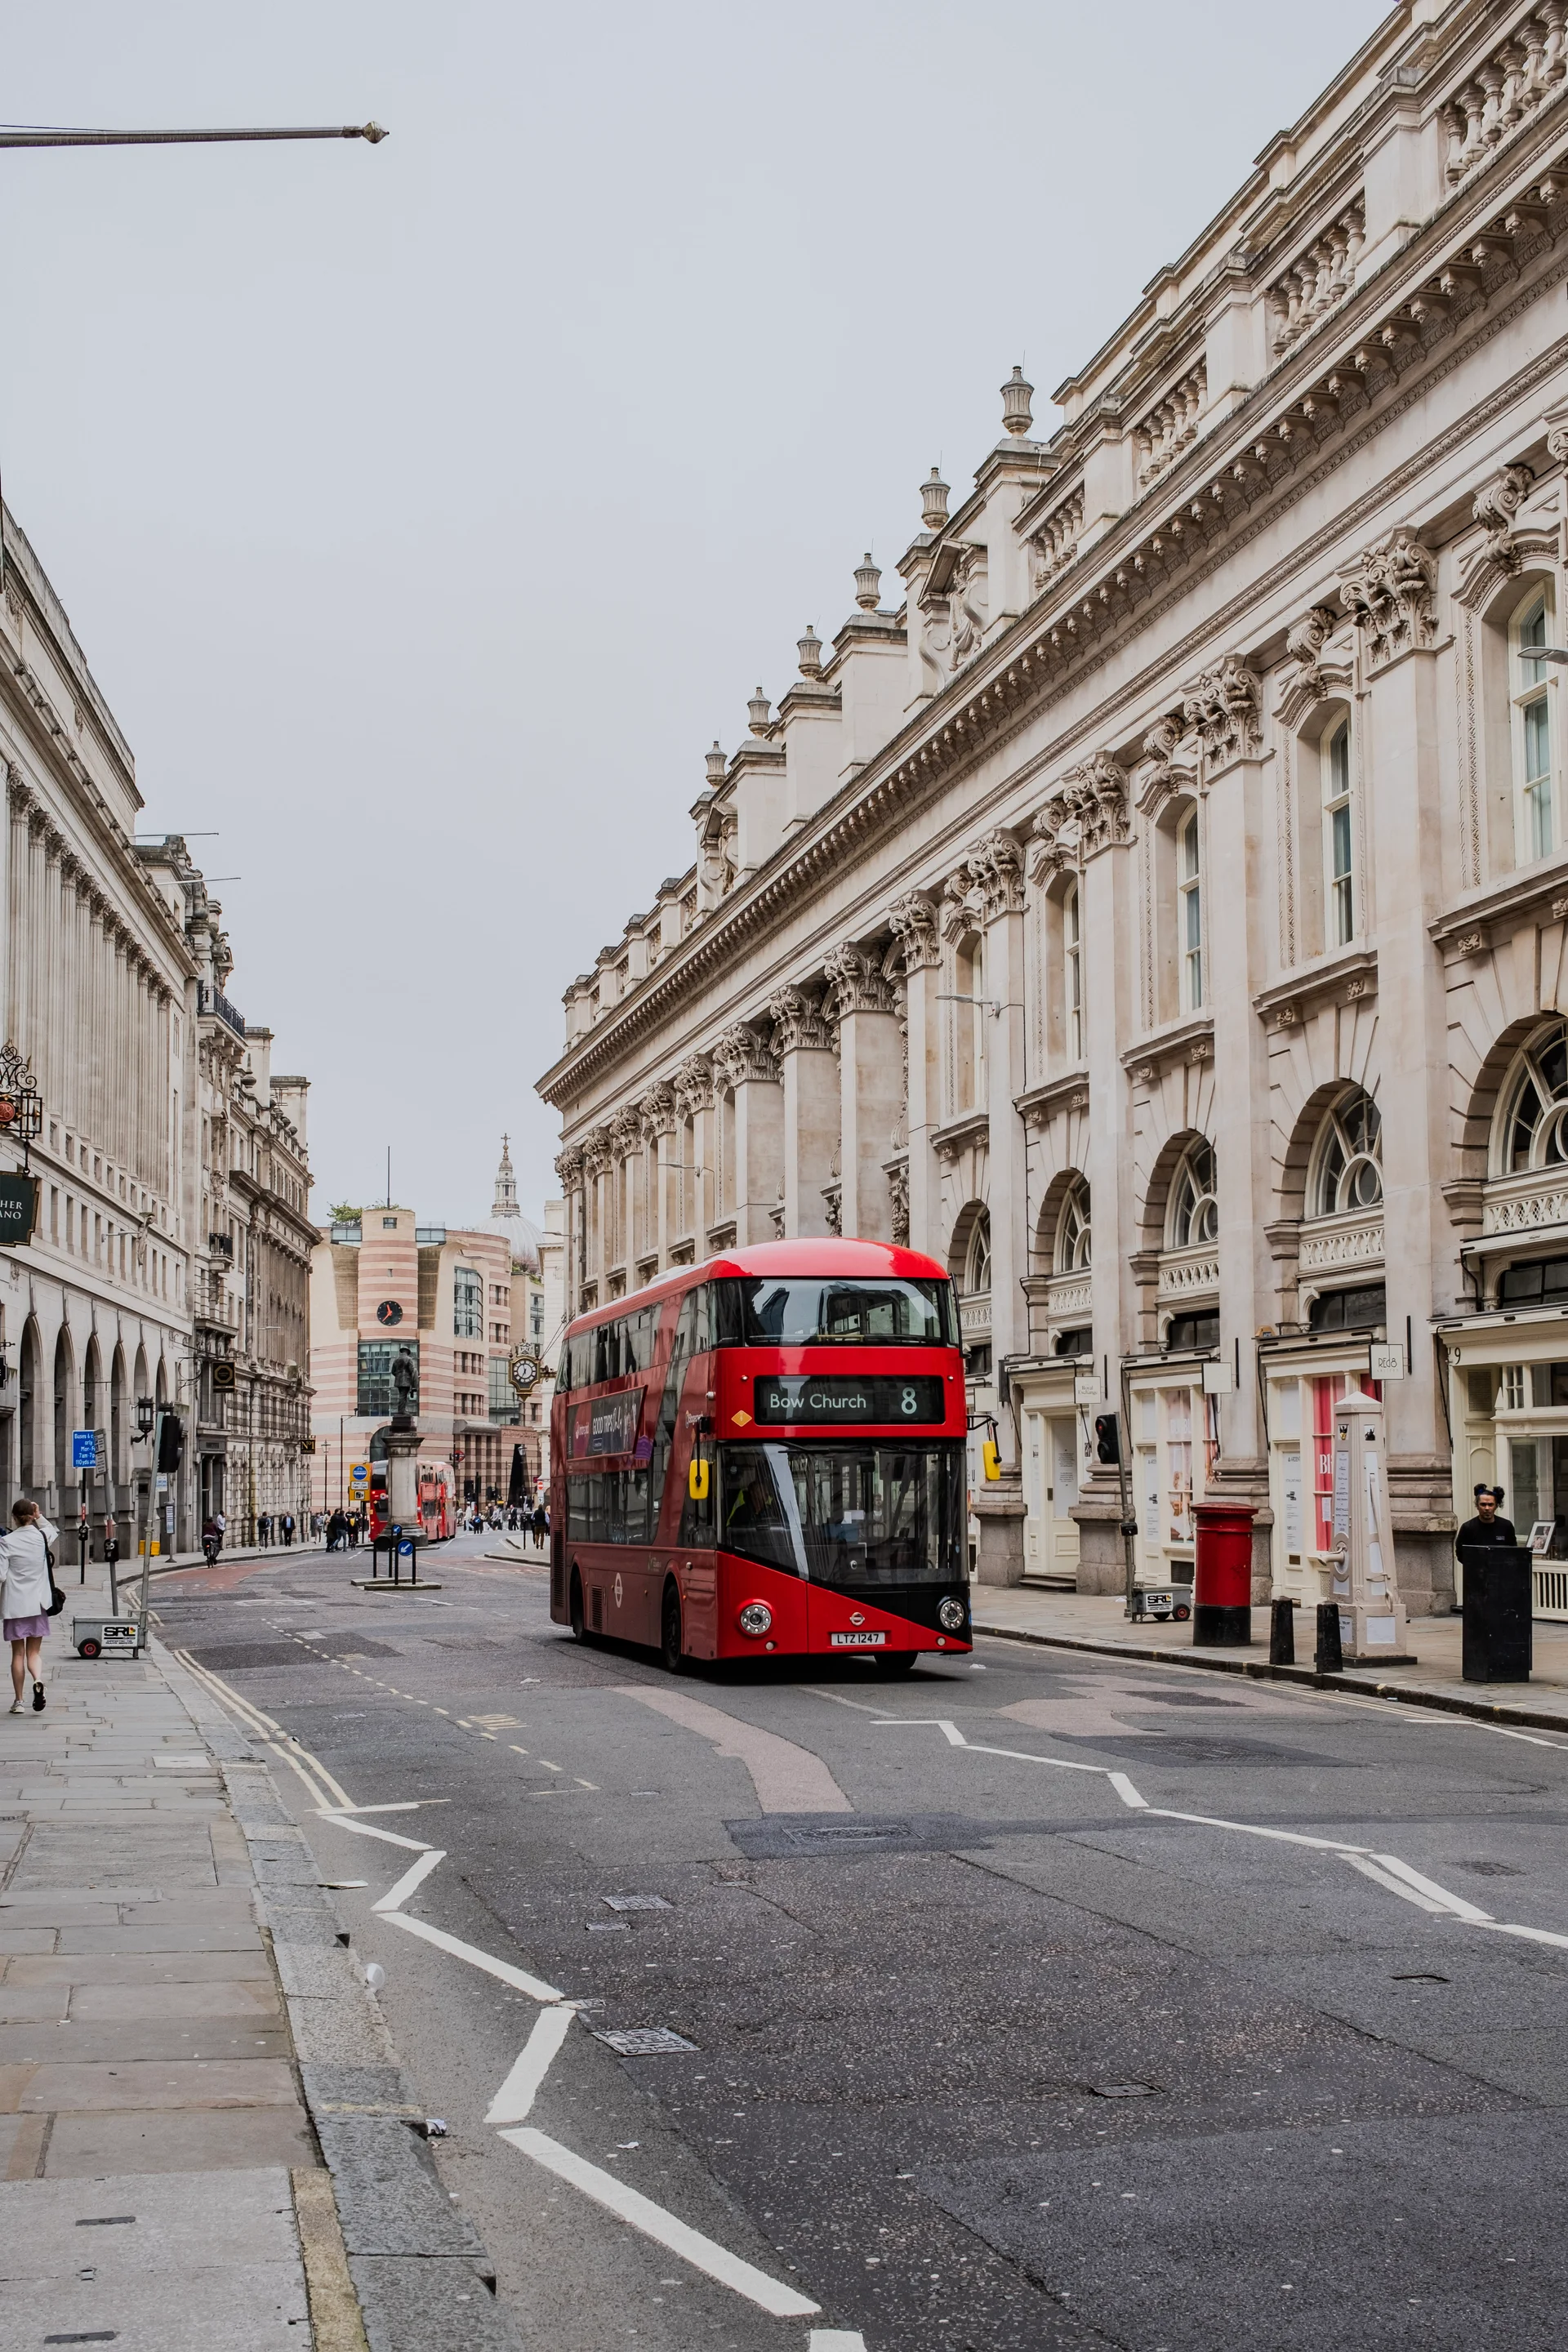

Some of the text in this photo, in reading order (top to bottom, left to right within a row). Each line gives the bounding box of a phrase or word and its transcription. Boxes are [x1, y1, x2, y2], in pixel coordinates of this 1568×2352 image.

[770, 1394, 866, 1408] Bow Church
[901, 1387, 917, 1414] 8
[1147, 1594, 1171, 1604] SRL
[104, 1626, 136, 1637] SRL
[837, 1633, 880, 1644] LTZ 1247
